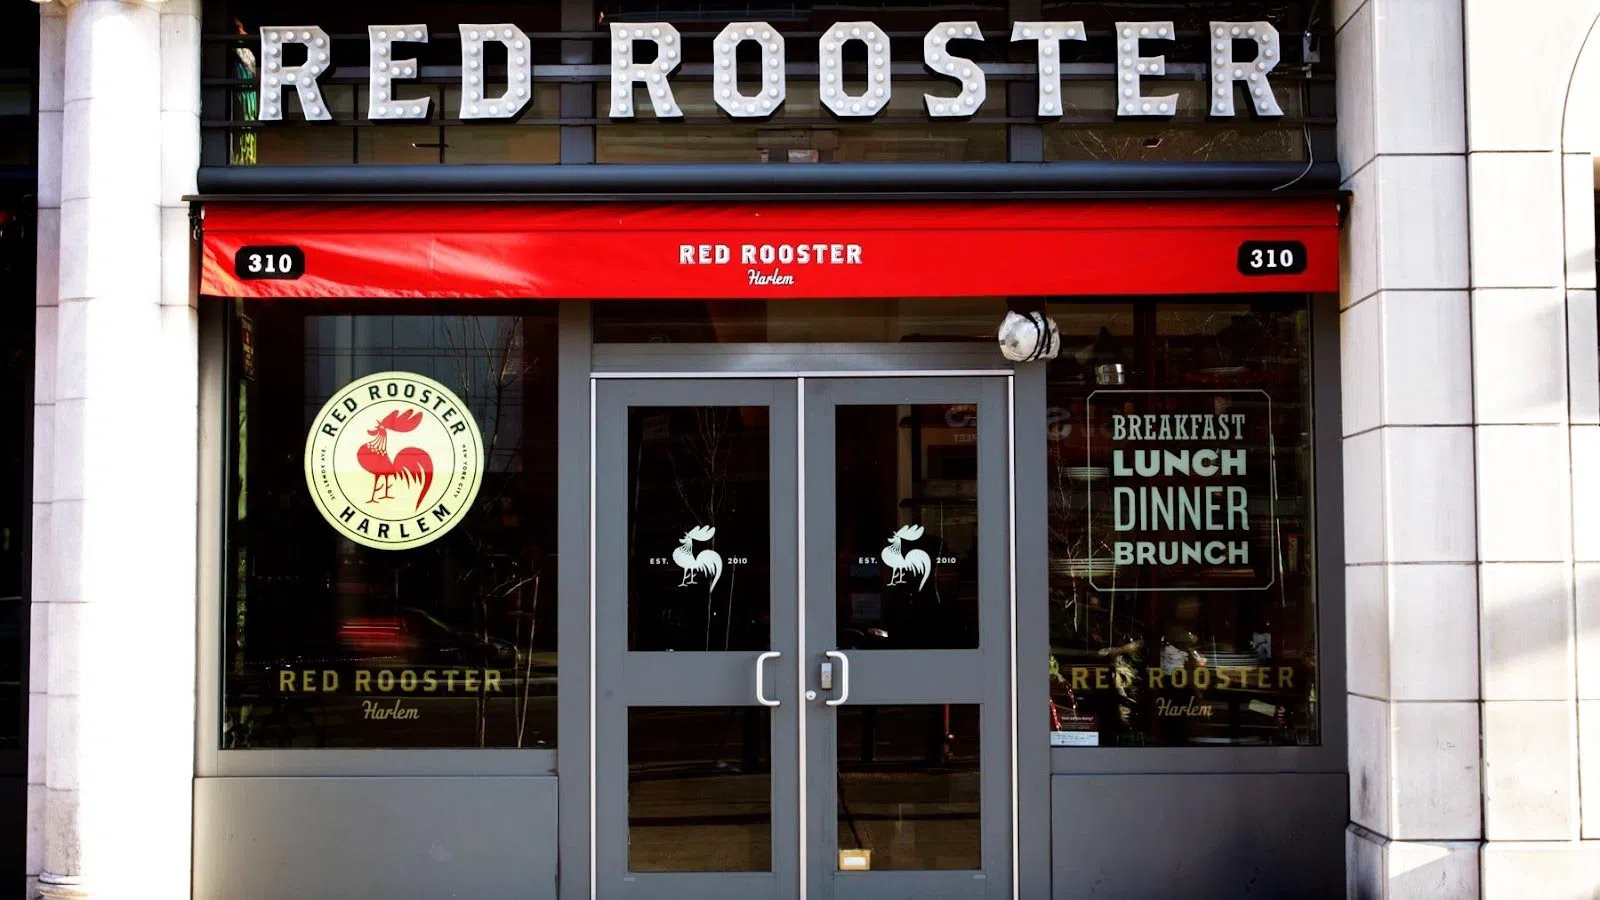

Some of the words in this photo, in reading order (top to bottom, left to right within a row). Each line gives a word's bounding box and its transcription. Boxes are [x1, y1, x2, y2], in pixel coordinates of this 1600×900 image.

[258, 24, 533, 121] RED
[609, 21, 1284, 118] ROOSTER
[248, 253, 293, 273] 310
[679, 244, 731, 264] RED
[741, 244, 863, 264] ROOSTER
[1250, 249, 1294, 268] 310
[748, 267, 794, 285] Harlem
[322, 397, 358, 438] RED
[368, 383, 466, 436] ROOSTER
[1112, 414, 1246, 441] BREAKFAST
[1113, 448, 1247, 477] LUNCH
[339, 503, 451, 539] HARLEM
[1113, 486, 1250, 532] DINNER
[650, 557, 669, 565] EST.
[936, 556, 957, 564] 2010
[1113, 540, 1249, 566] BRUNCH
[279, 669, 339, 692] RED
[354, 668, 502, 692] ROOSTER
[1149, 666, 1295, 690] ROOSTER
[362, 699, 420, 720] Harlem
[1155, 695, 1213, 717] Harlem
